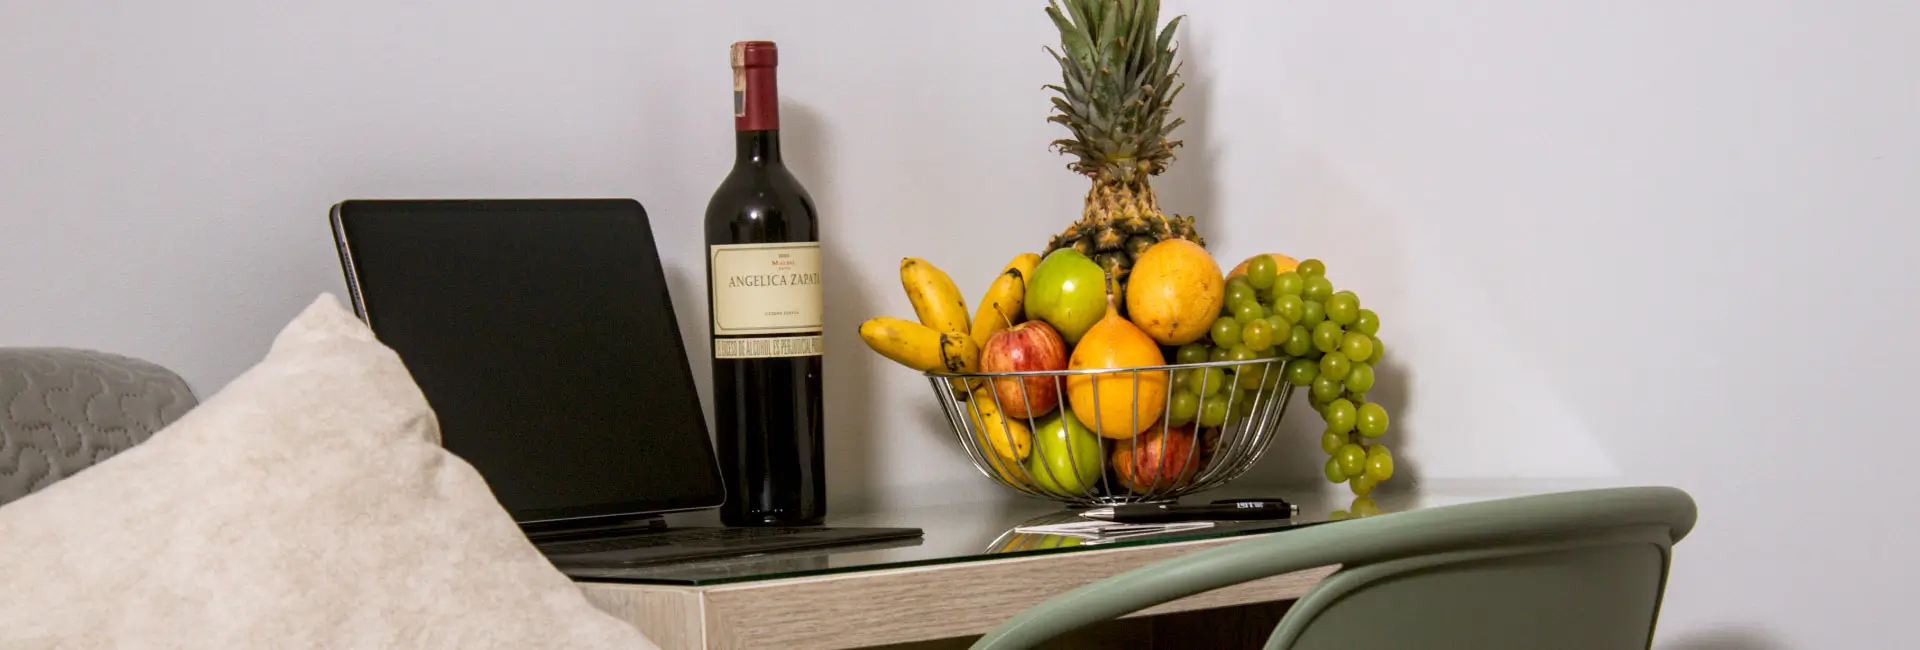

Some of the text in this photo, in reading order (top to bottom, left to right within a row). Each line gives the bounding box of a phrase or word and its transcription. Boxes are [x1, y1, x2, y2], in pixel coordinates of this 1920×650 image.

[729, 274, 787, 288] ANGELICA
[738, 340, 745, 356] DE
[746, 340, 771, 356] ALCOHOL
[773, 339, 780, 355] ES
